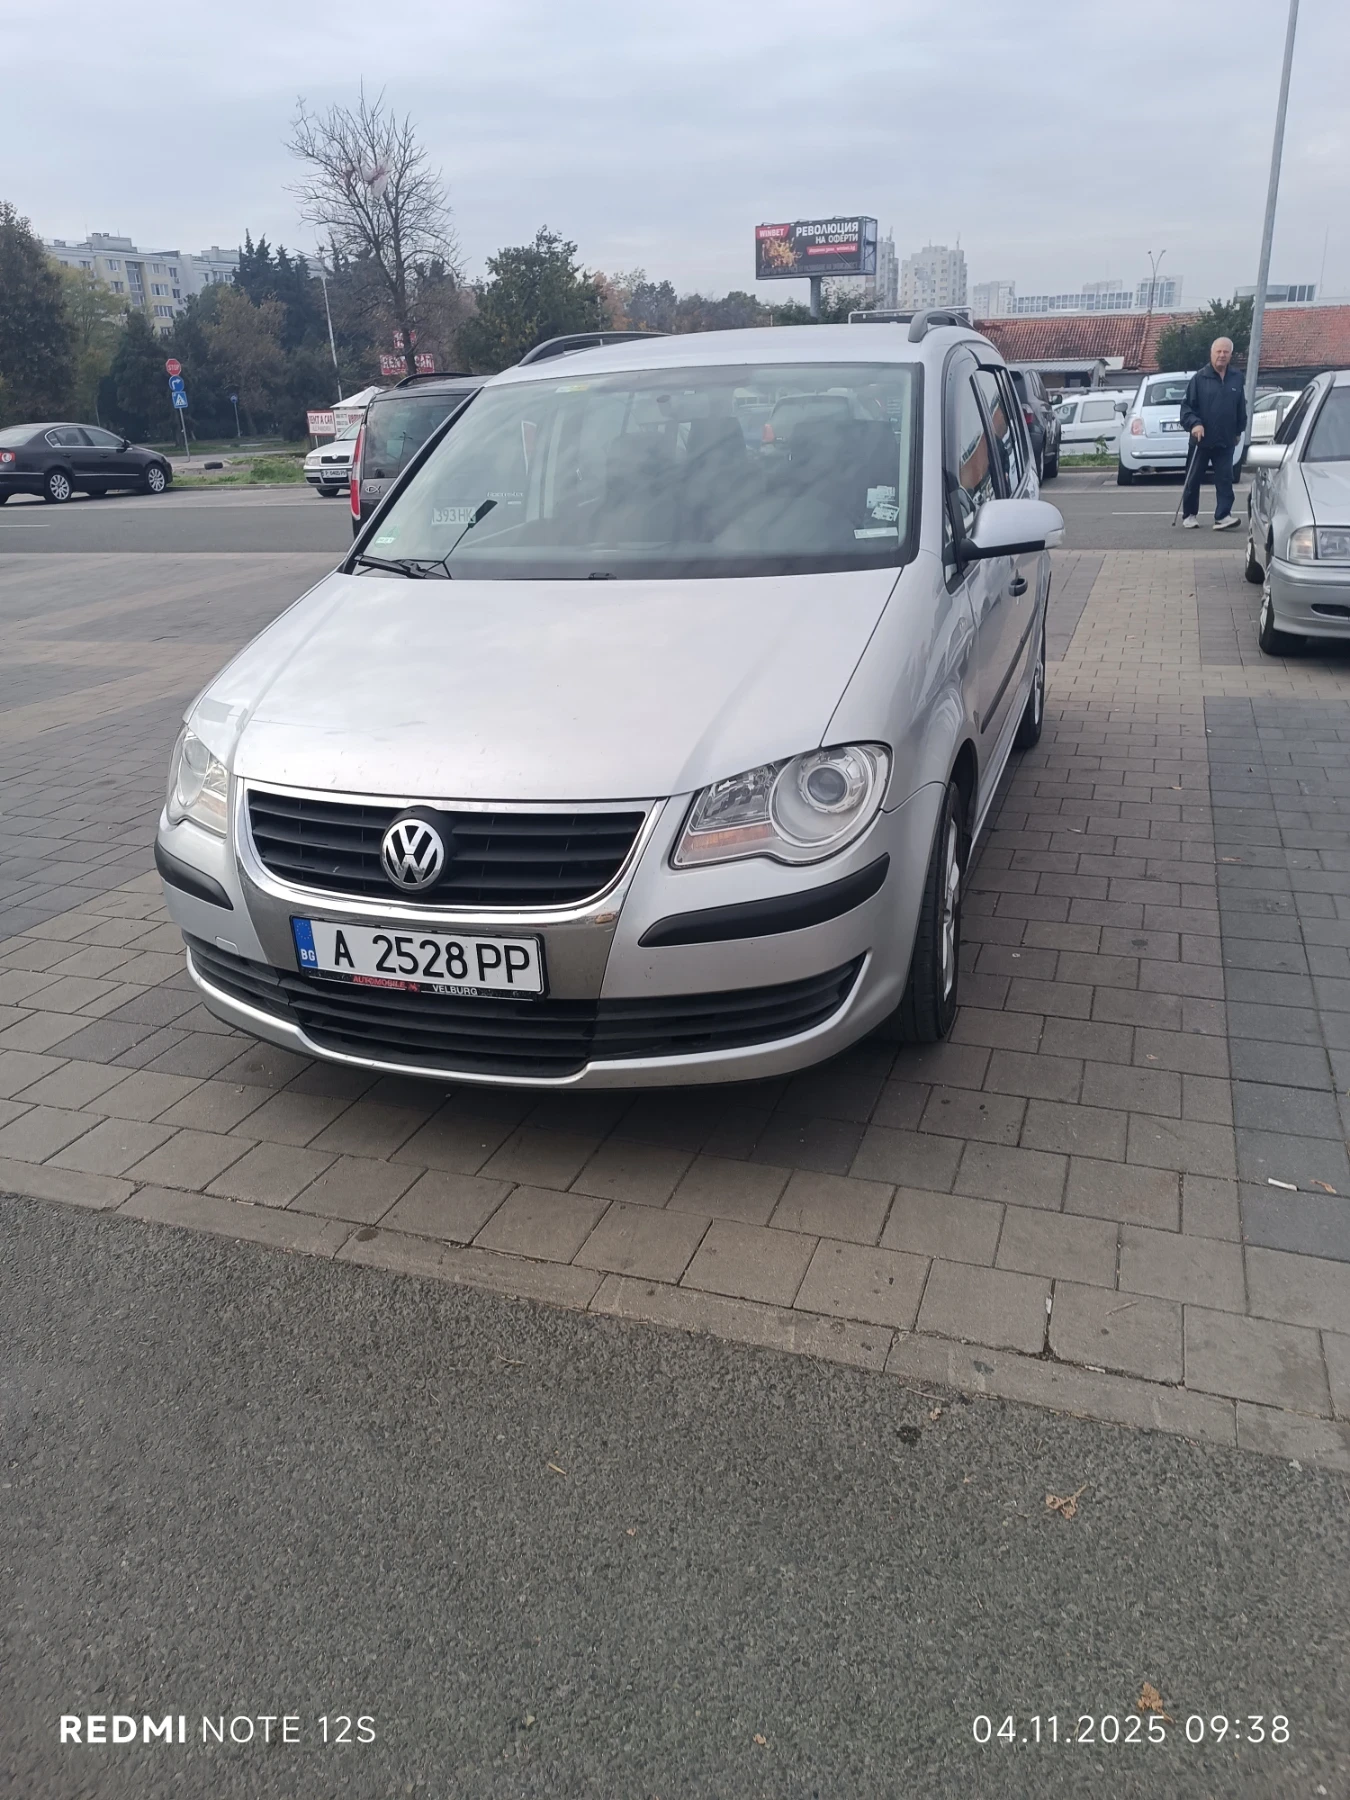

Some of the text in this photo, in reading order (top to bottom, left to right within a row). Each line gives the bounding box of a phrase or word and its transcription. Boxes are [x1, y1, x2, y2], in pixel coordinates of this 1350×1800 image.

[759, 228, 785, 238] WINBET
[796, 222, 859, 237] РЕВОЛЮЦИЯ
[815, 234, 858, 244] НА ОФЕРТИ
[324, 415, 333, 424] CAR
[301, 949, 315, 961] BG
[334, 930, 530, 983] A 2528 PP
[353, 975, 406, 988] AUTOMOBILE
[433, 984, 478, 996] VELBURG
